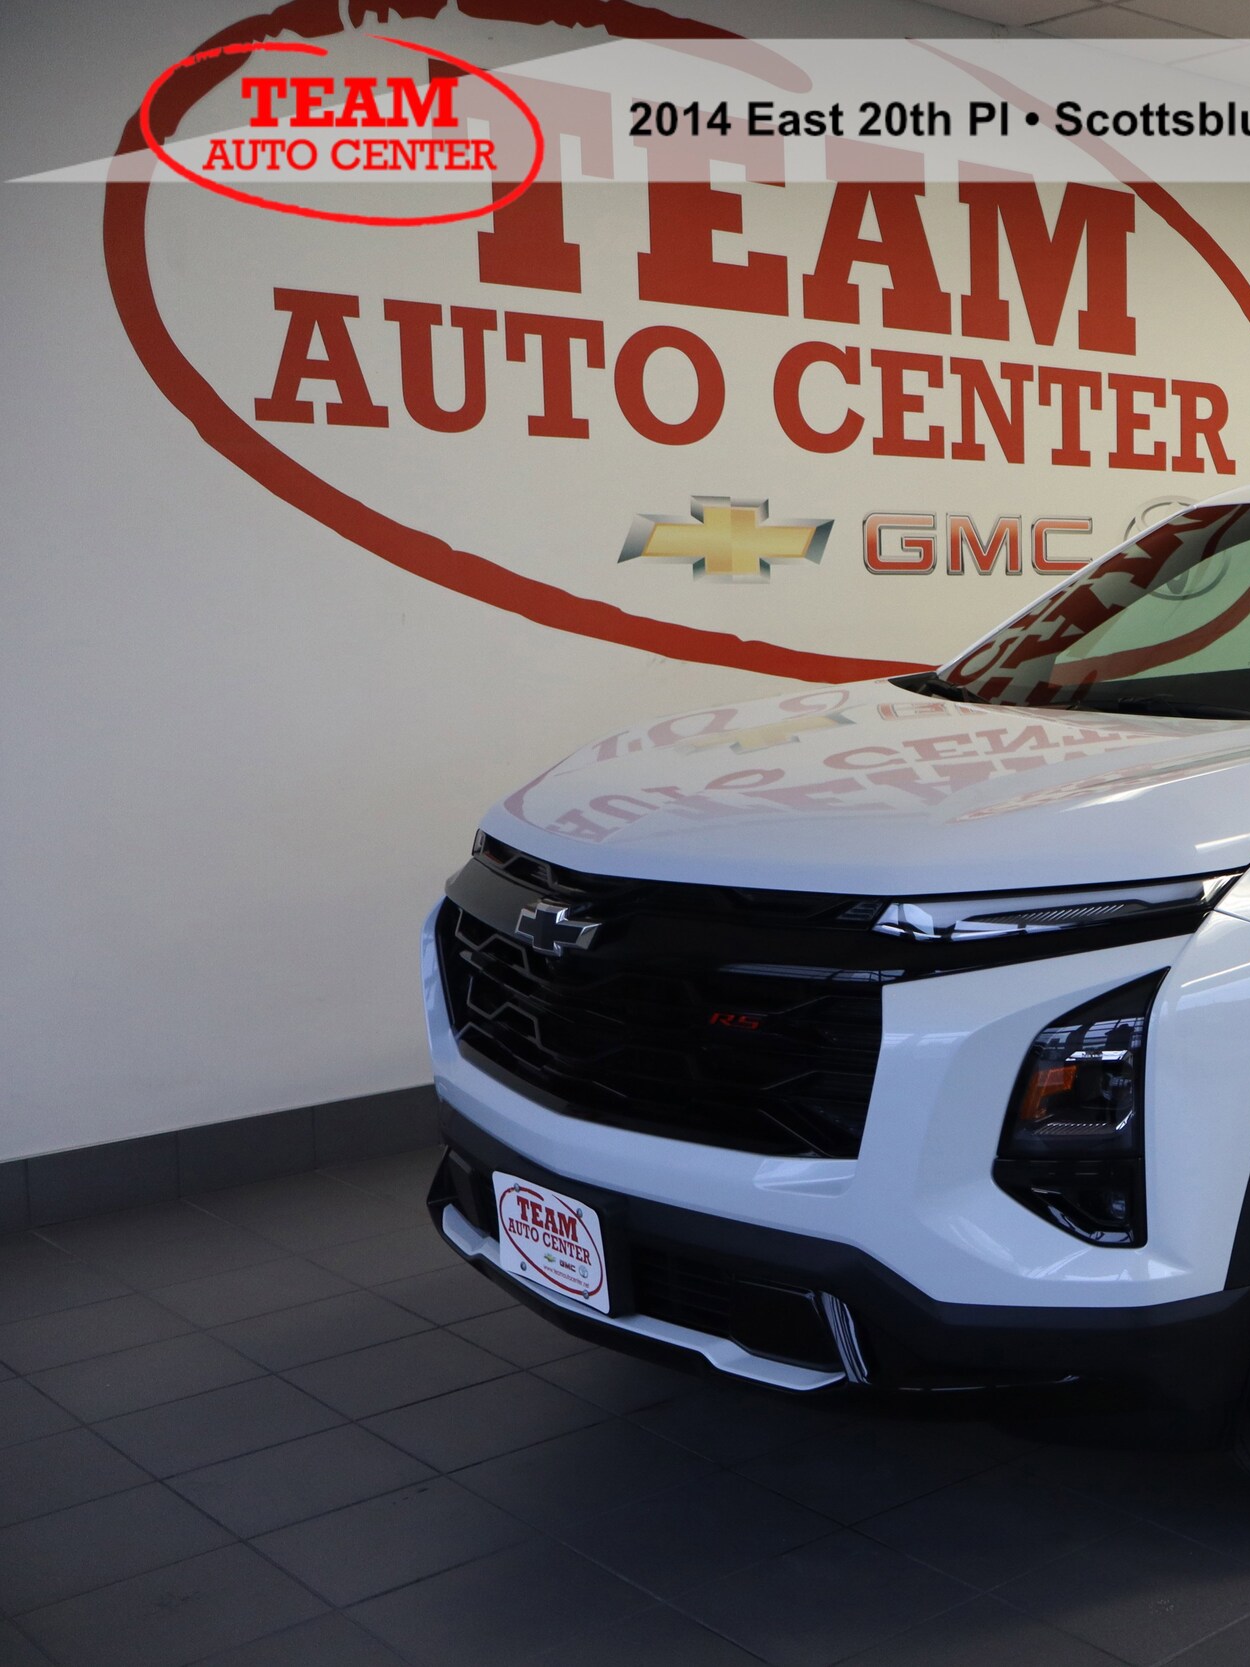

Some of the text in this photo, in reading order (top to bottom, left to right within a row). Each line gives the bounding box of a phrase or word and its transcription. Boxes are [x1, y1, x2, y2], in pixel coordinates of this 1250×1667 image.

[428, 58, 1137, 356] TEAM
[254, 287, 1237, 475] AUTO CENTER
[862, 511, 1094, 577] GMC
[709, 1012, 760, 1031] RS
[508, 1217, 592, 1266] AUTO CENTER
[516, 1195, 578, 1243] TEAM
[559, 1259, 576, 1273] GMC
